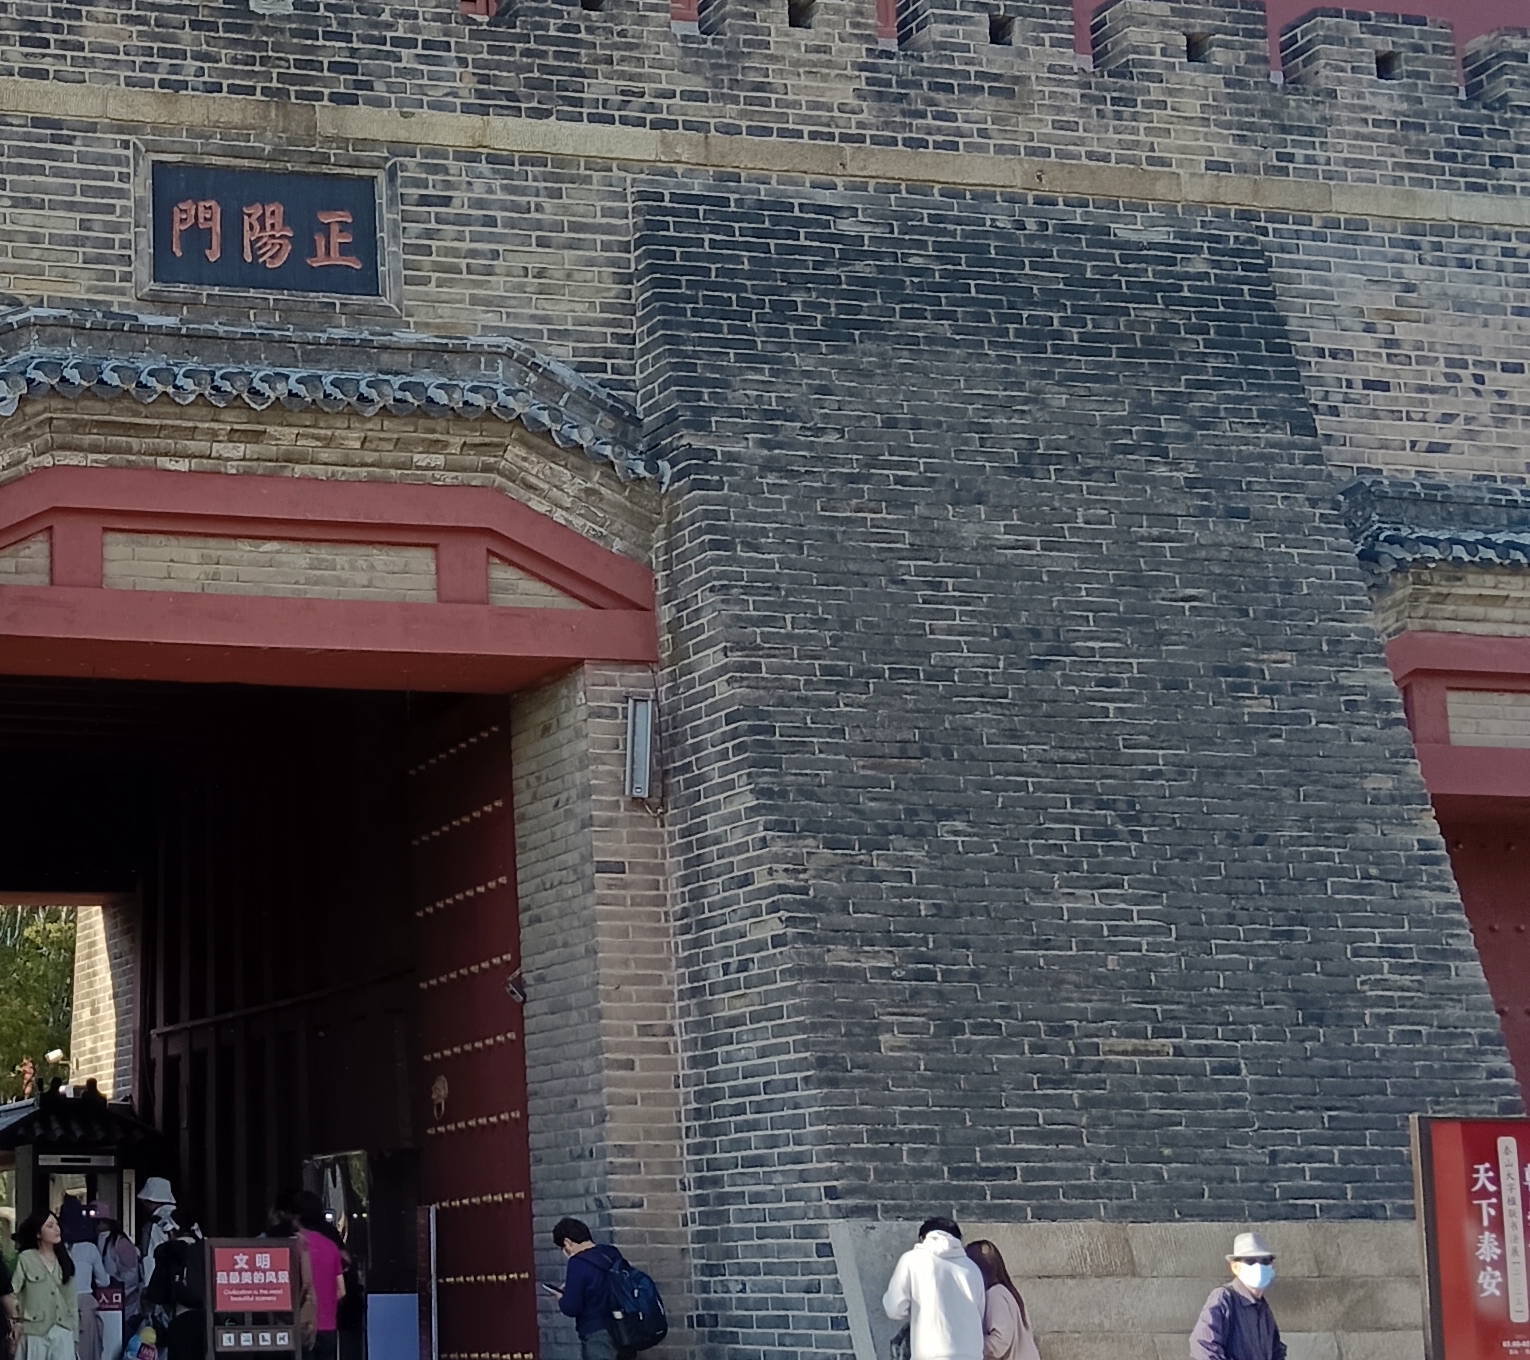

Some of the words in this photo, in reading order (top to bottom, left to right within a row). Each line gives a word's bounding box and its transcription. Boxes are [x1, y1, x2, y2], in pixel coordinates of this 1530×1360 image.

[1471, 1162, 1503, 1298] 天下泰安
[233, 1253, 270, 1269] 文明
[216, 1270, 289, 1284] 是最美的风景
[99, 1293, 122, 1304] 入口
